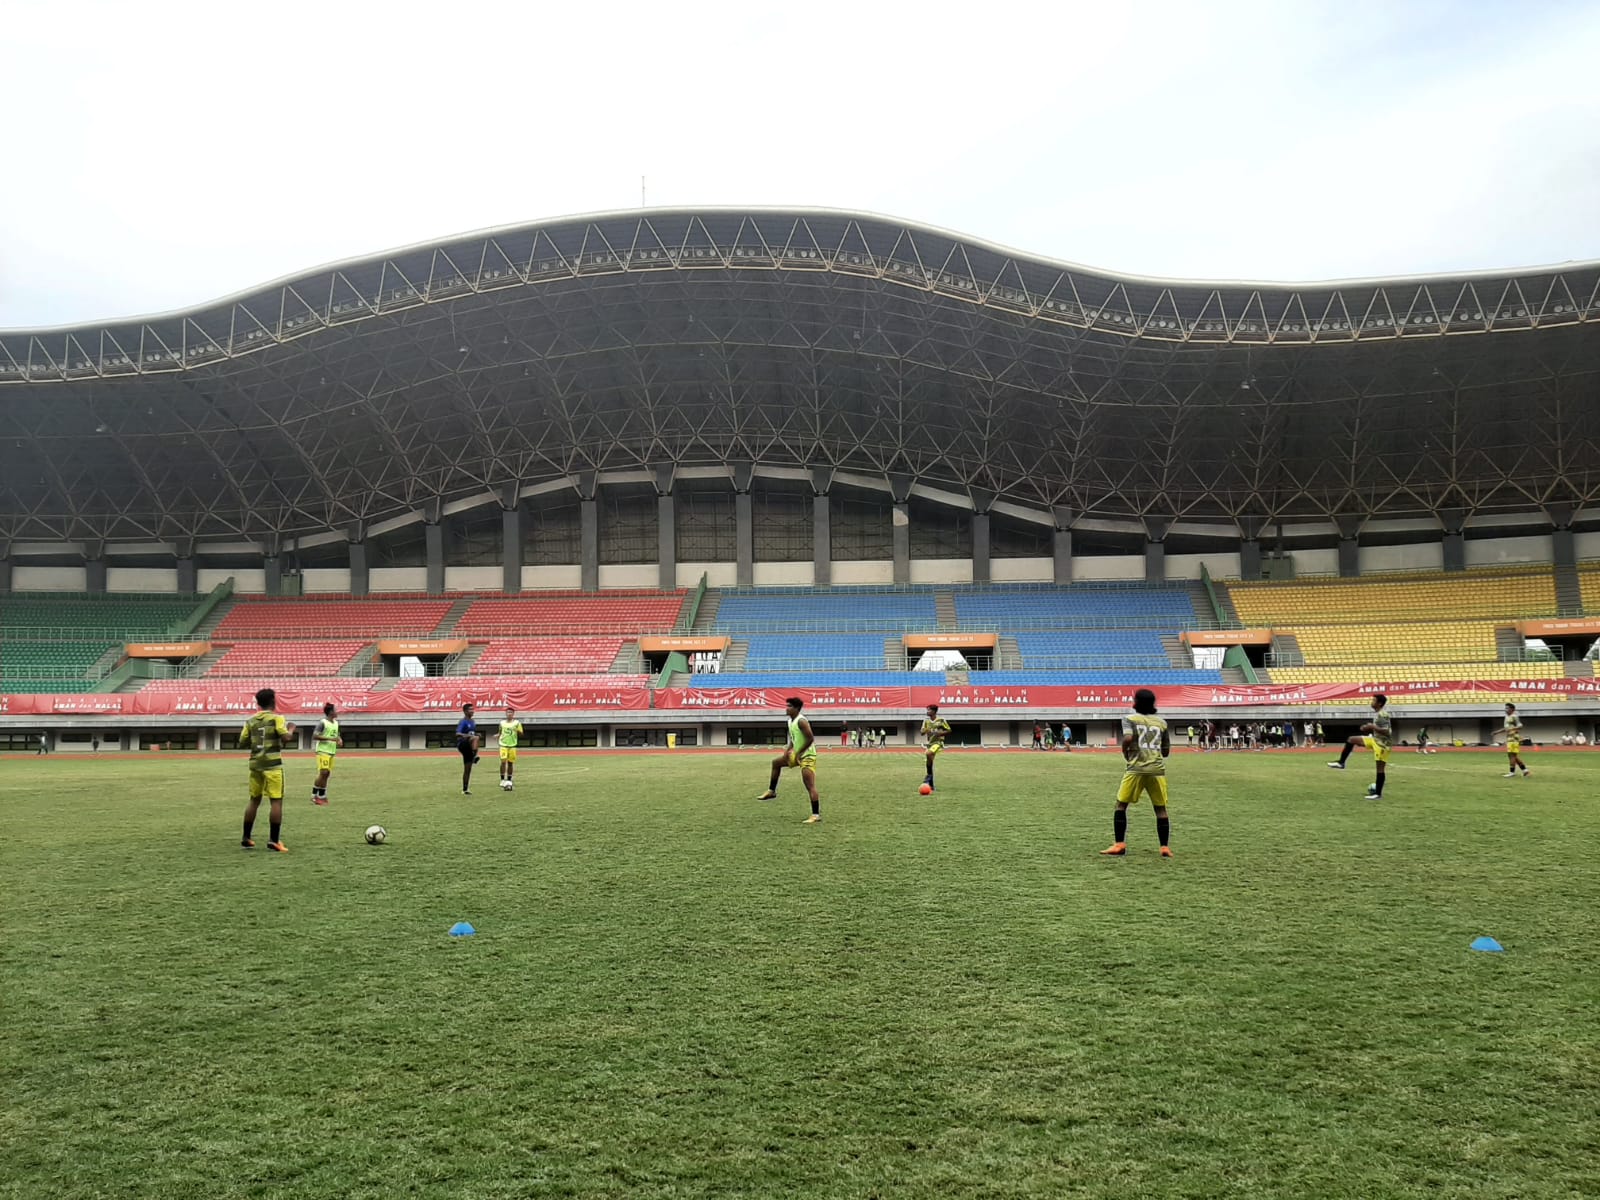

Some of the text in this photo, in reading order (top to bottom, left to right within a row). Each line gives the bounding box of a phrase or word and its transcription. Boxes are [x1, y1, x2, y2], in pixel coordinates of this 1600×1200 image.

[1408, 681, 1440, 690] HALAL
[1509, 681, 1546, 690] AMAN
[939, 696, 969, 704] AMAN
[973, 696, 990, 704] dan
[1211, 695, 1243, 703] AMAN
[1270, 692, 1307, 700] HALAL
[225, 702, 257, 710] HALAL
